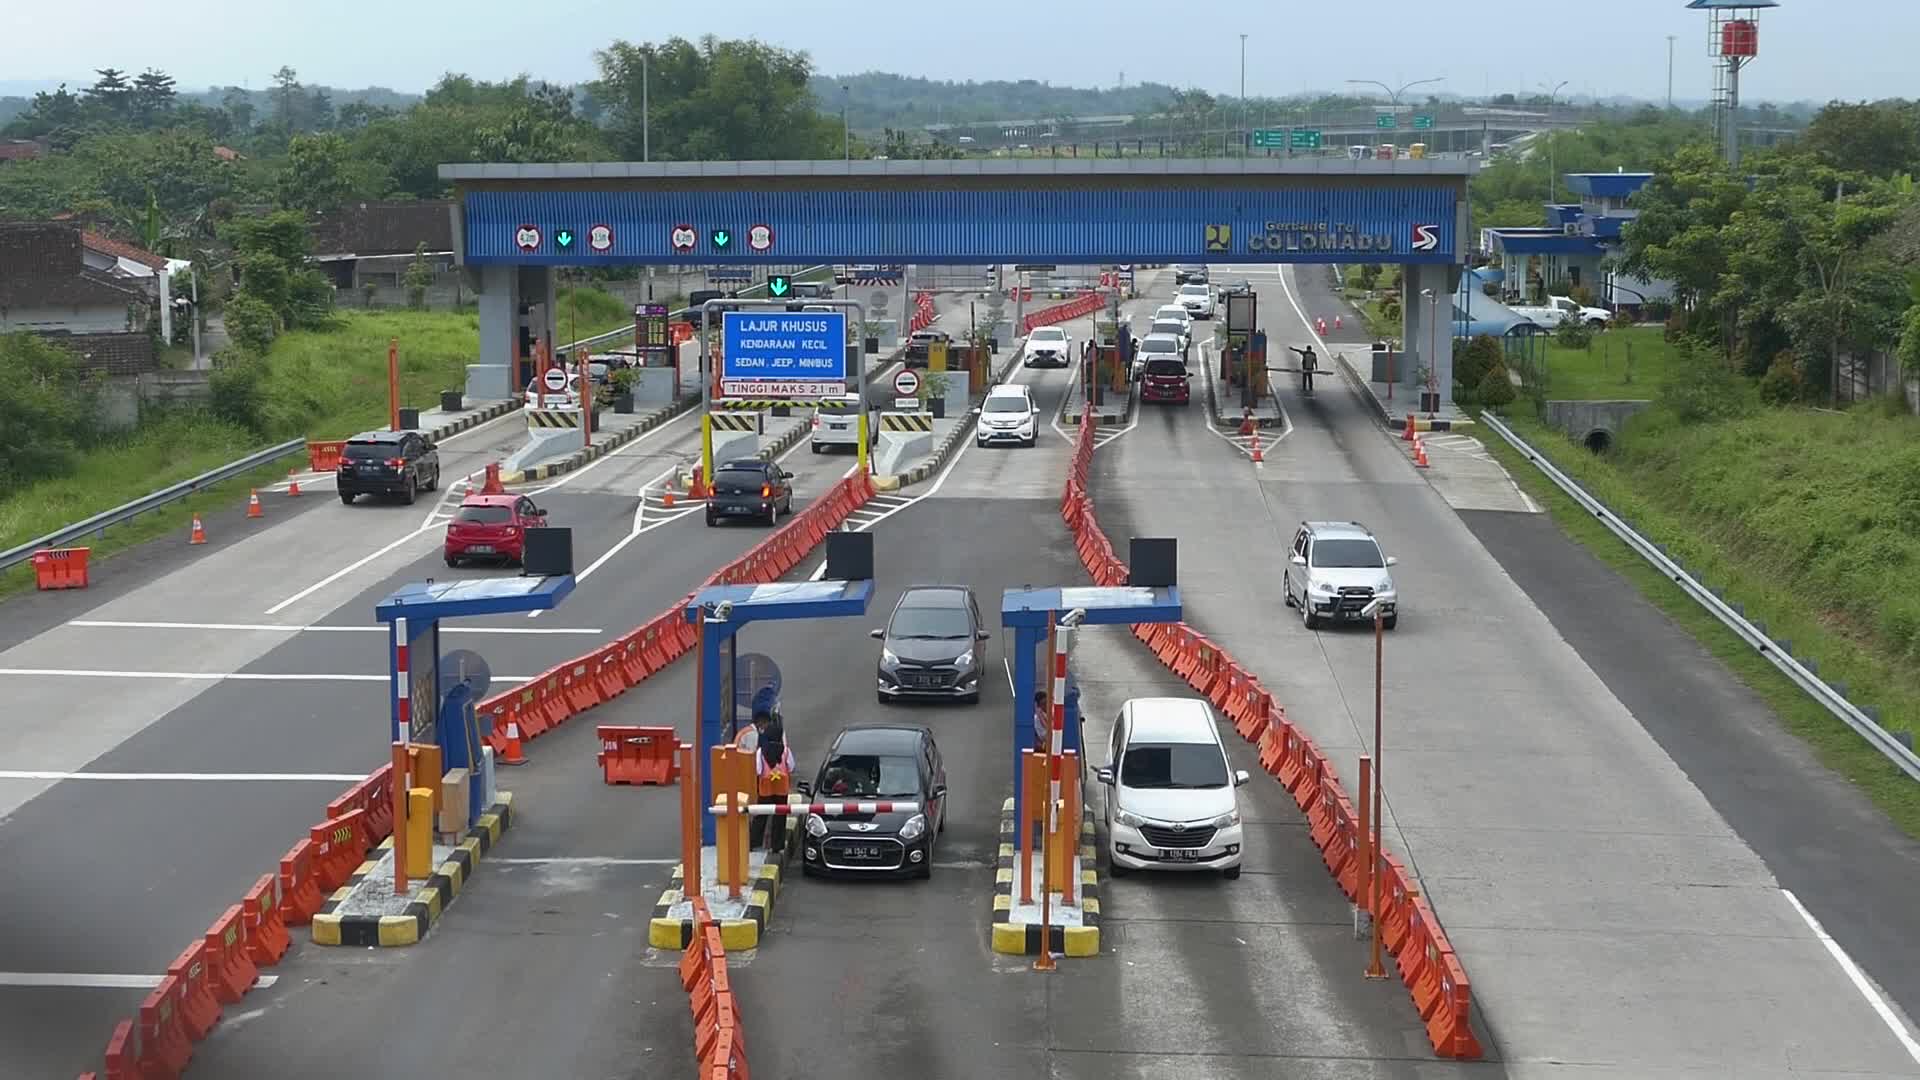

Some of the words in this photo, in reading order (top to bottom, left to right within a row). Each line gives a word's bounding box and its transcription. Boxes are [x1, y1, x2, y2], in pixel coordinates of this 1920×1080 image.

[1248, 233, 1392, 250] COLOMADU
[740, 320, 778, 332] LAJUR
[781, 320, 828, 332] KHUSUS
[740, 339, 796, 349] KENDARAAN
[801, 339, 828, 349] KECIL
[799, 357, 833, 369] MINIBUS
[730, 384, 768, 393] TINGGI
[771, 384, 805, 393] MAKS
